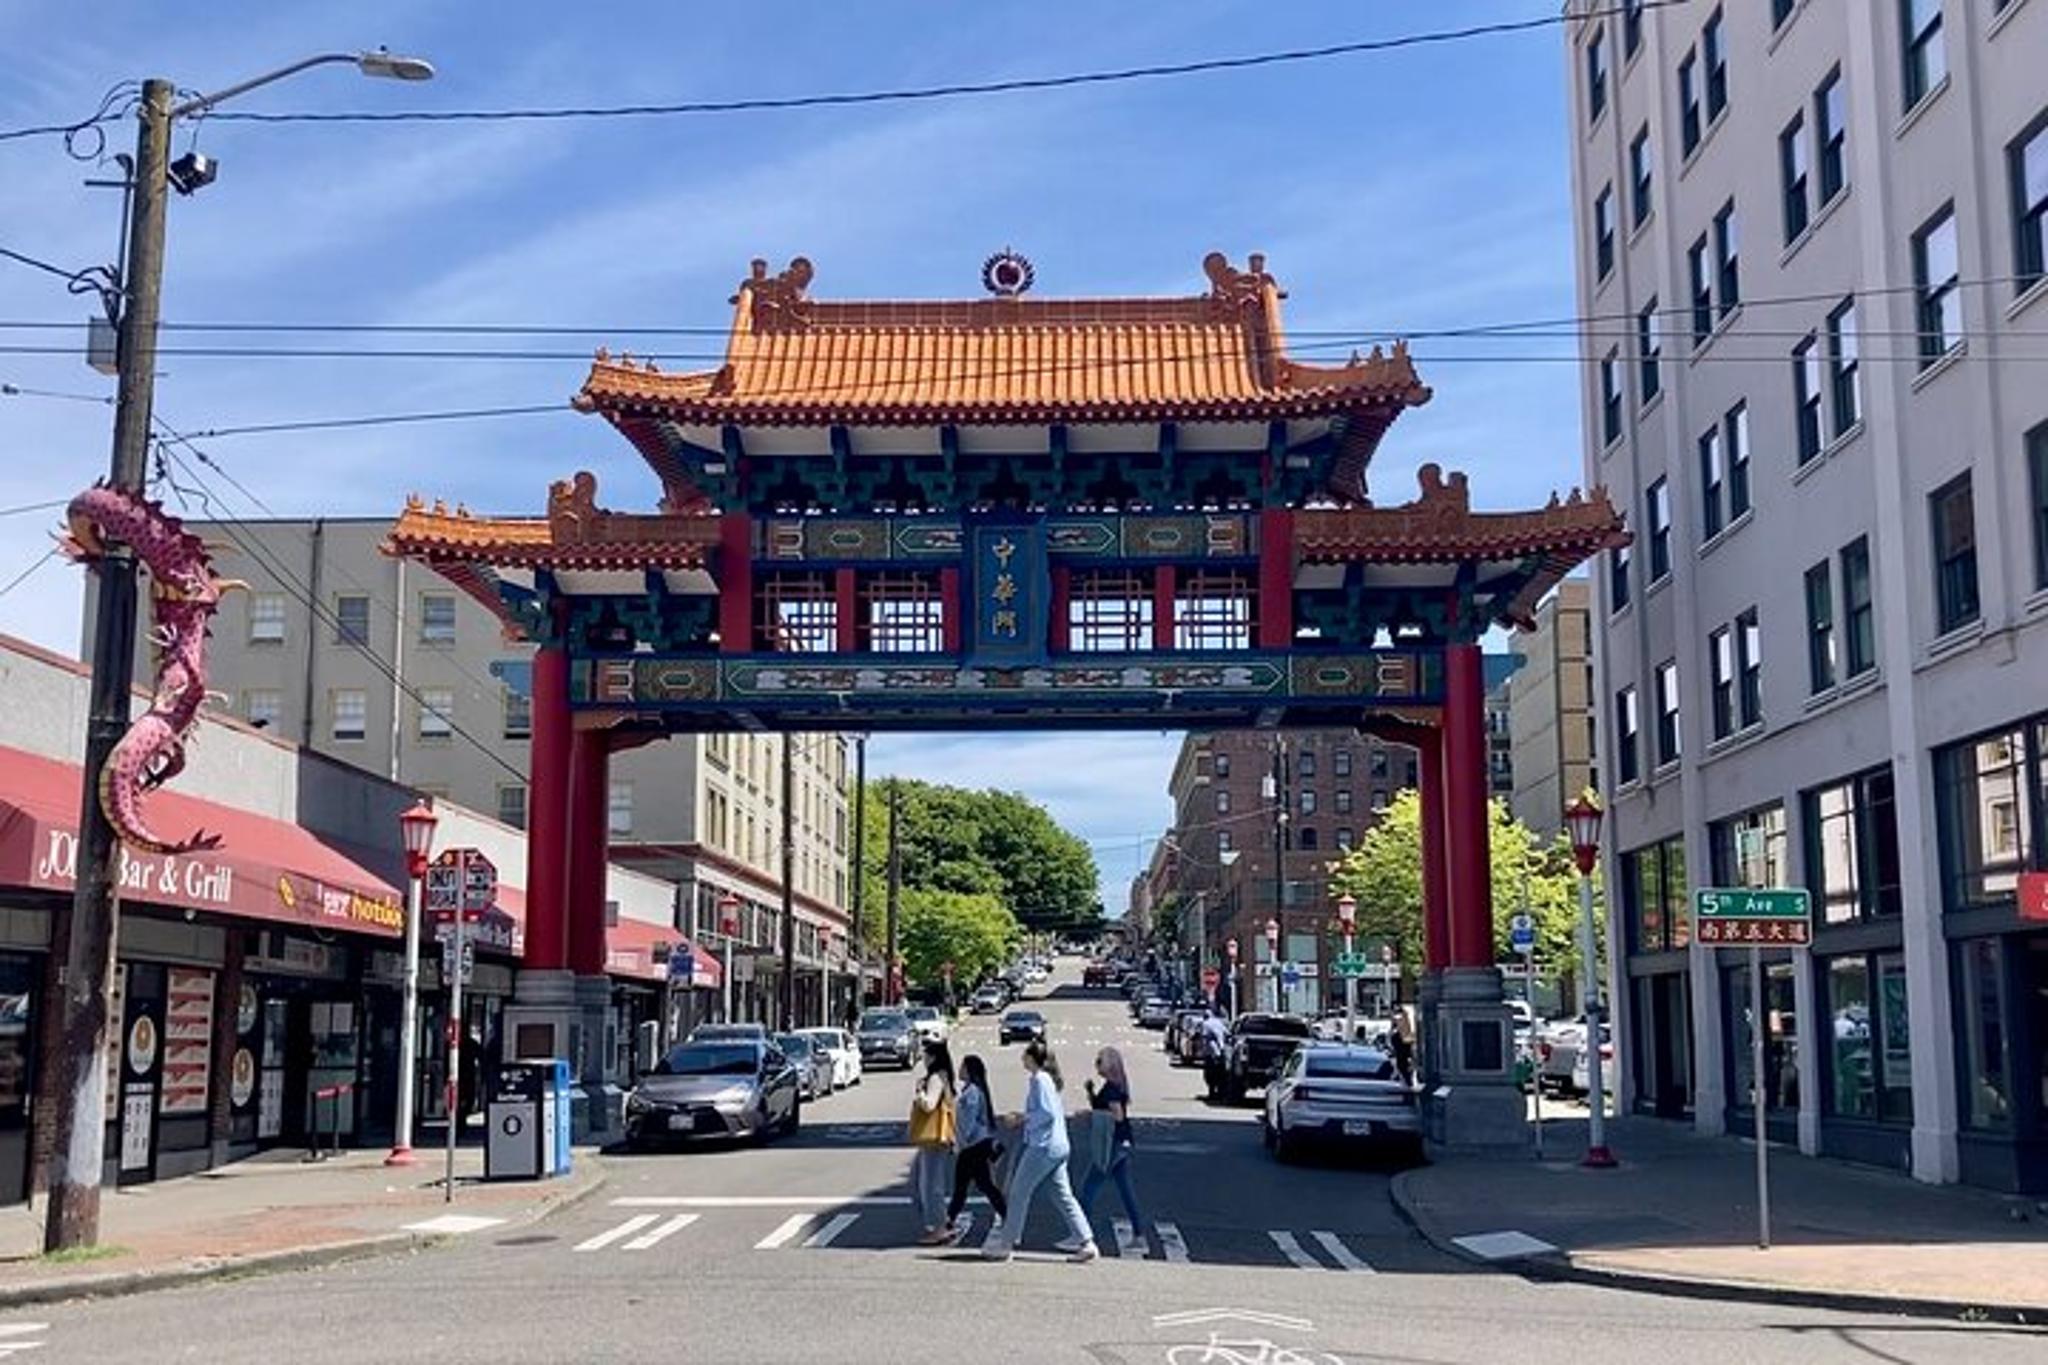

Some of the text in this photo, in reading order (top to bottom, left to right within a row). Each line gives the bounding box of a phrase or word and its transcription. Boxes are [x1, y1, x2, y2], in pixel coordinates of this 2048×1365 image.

[158, 855, 179, 894] &
[185, 860, 232, 903] Grill
[1701, 894, 1805, 914] 5th Ave S
